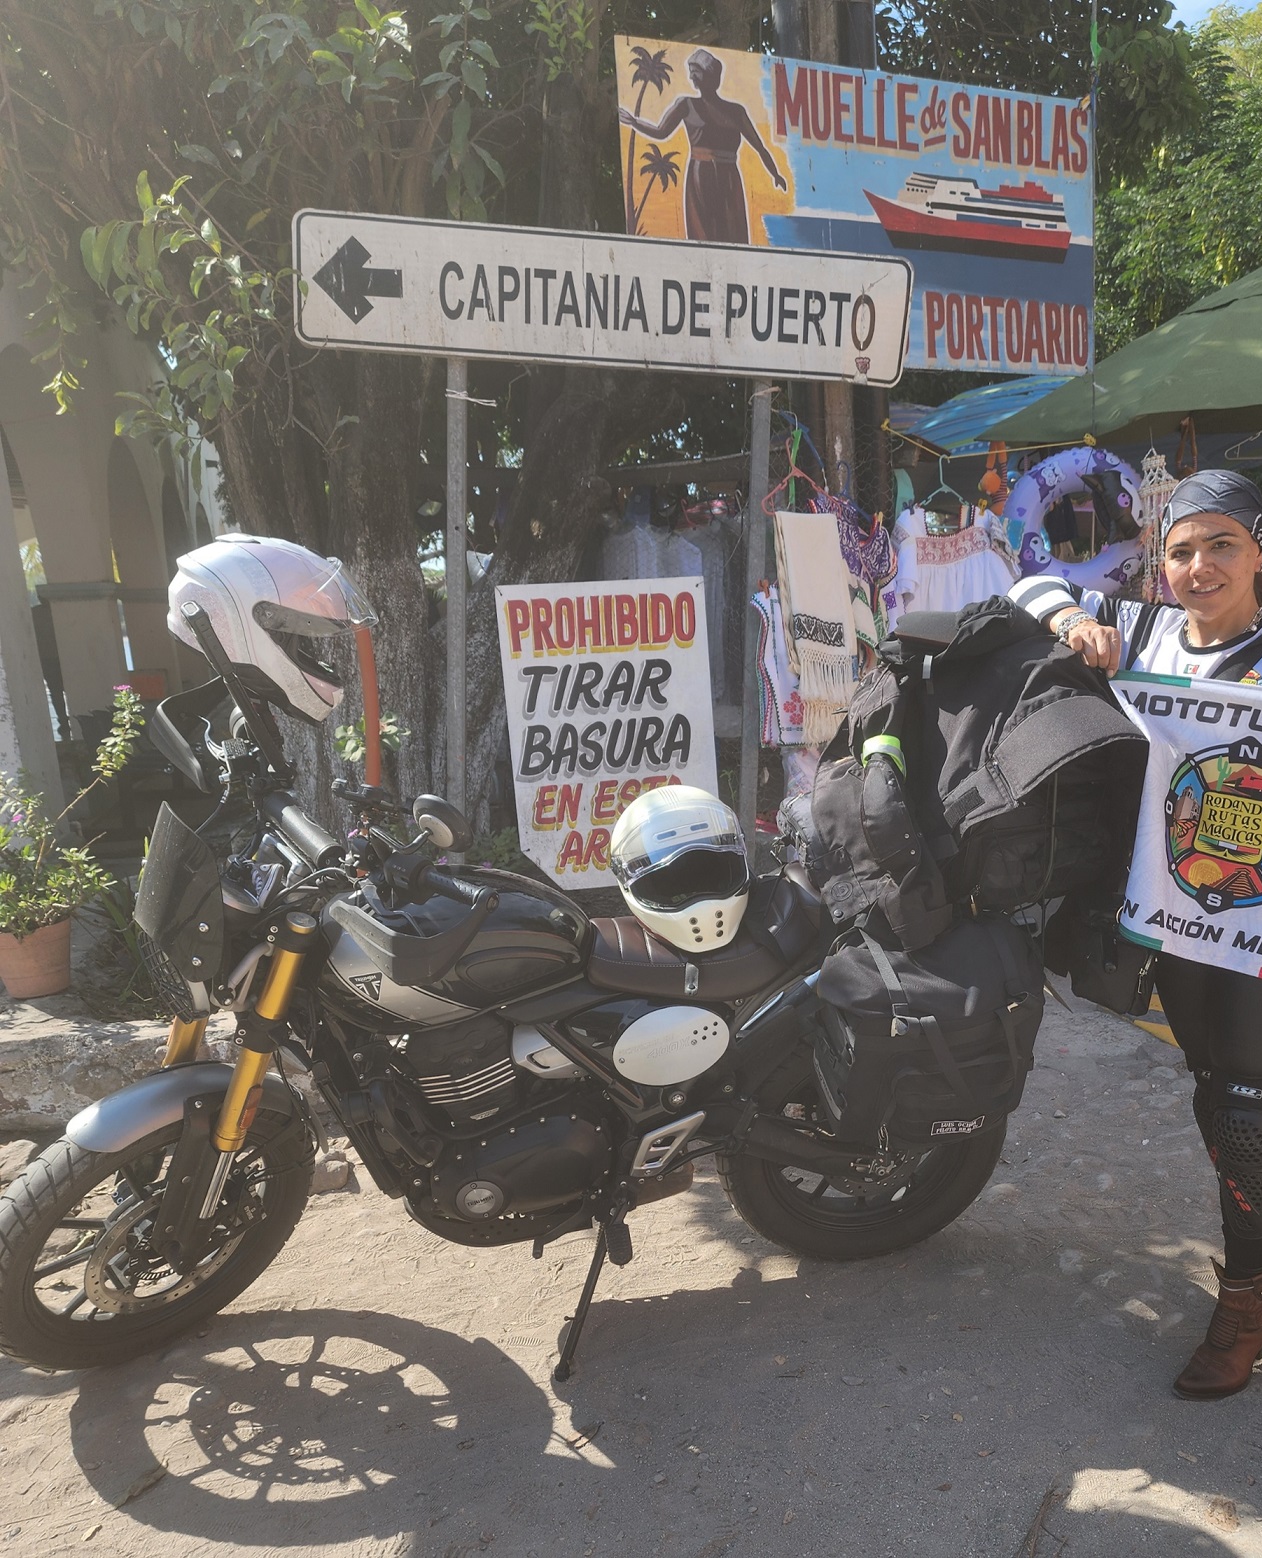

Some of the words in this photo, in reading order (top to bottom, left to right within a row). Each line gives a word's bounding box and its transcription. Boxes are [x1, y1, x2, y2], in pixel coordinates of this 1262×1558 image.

[773, 63, 919, 152] MUELLE
[920, 85, 946, 147] de
[951, 92, 1012, 164] SAN
[1017, 100, 1088, 173] BLAS
[439, 261, 649, 333] CAPITANIA
[661, 279, 711, 337] DE
[726, 283, 876, 351] PUERTO
[924, 291, 1089, 367] PORTOARIO
[504, 592, 696, 658] PROHIBIDO
[519, 659, 672, 718] TIRAR
[517, 713, 691, 781] BASURA
[532, 783, 583, 830] EN
[590, 775, 682, 825] ES
